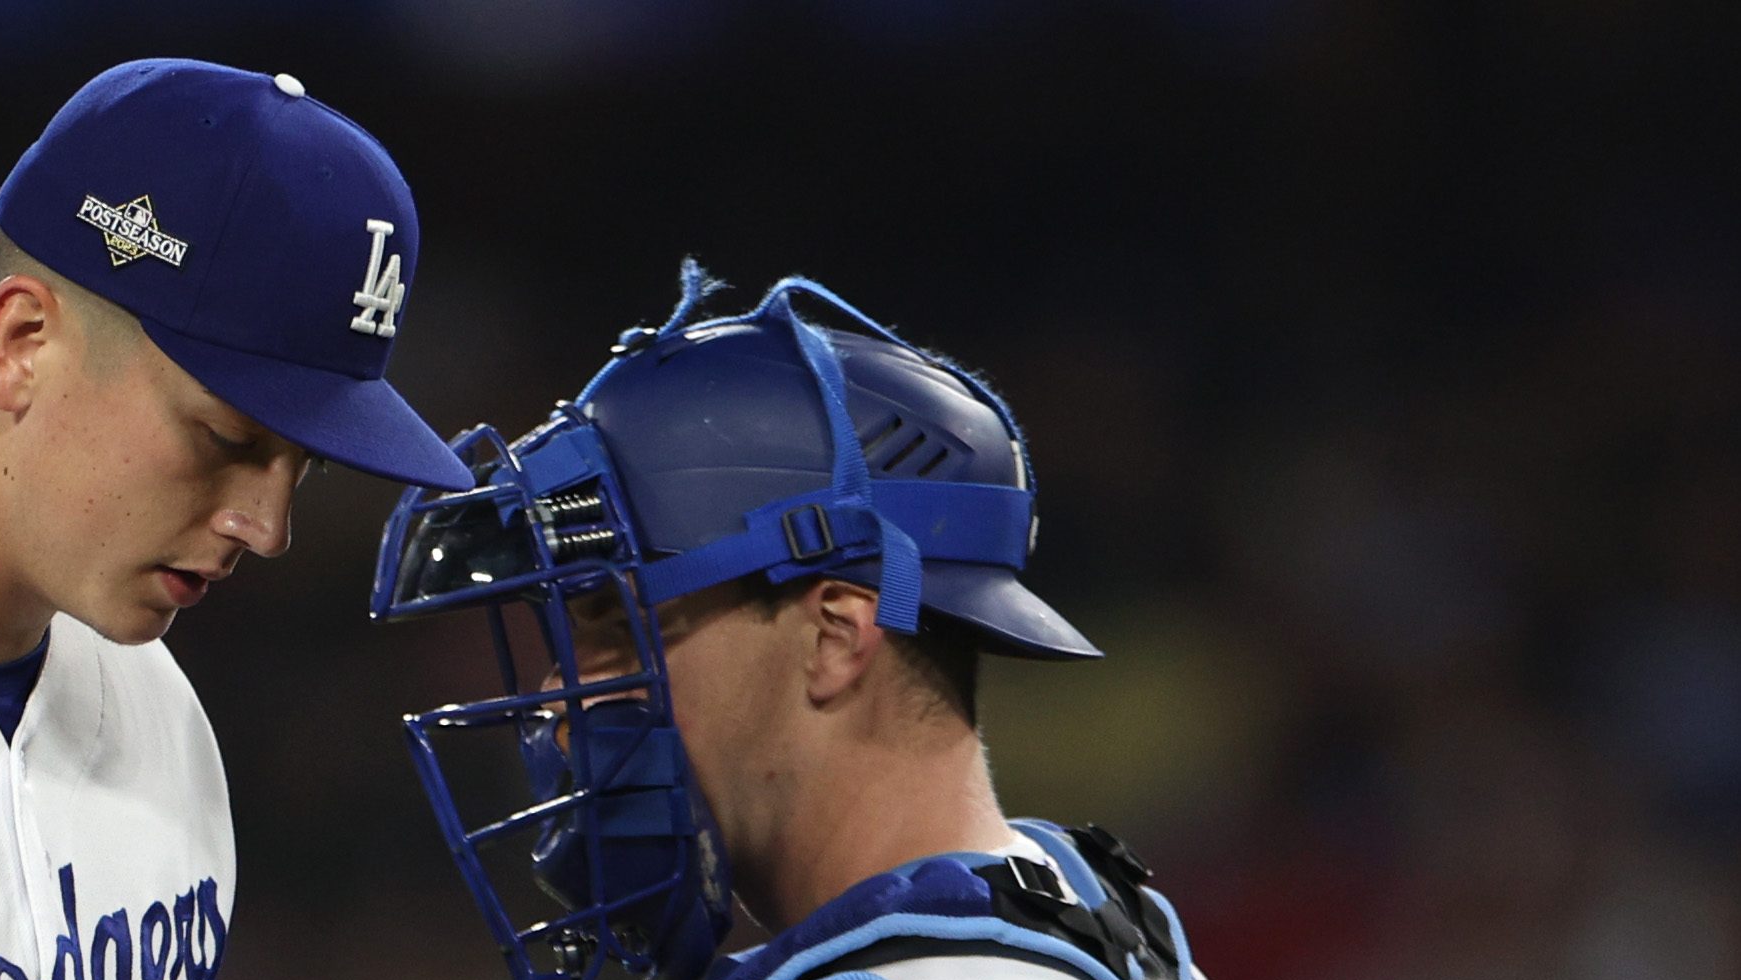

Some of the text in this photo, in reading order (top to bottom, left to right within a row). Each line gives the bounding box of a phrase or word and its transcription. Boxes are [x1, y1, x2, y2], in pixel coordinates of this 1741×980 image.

[80, 199, 187, 262] POSTSEASON
[109, 235, 139, 256] 2023
[350, 218, 405, 338] LA
